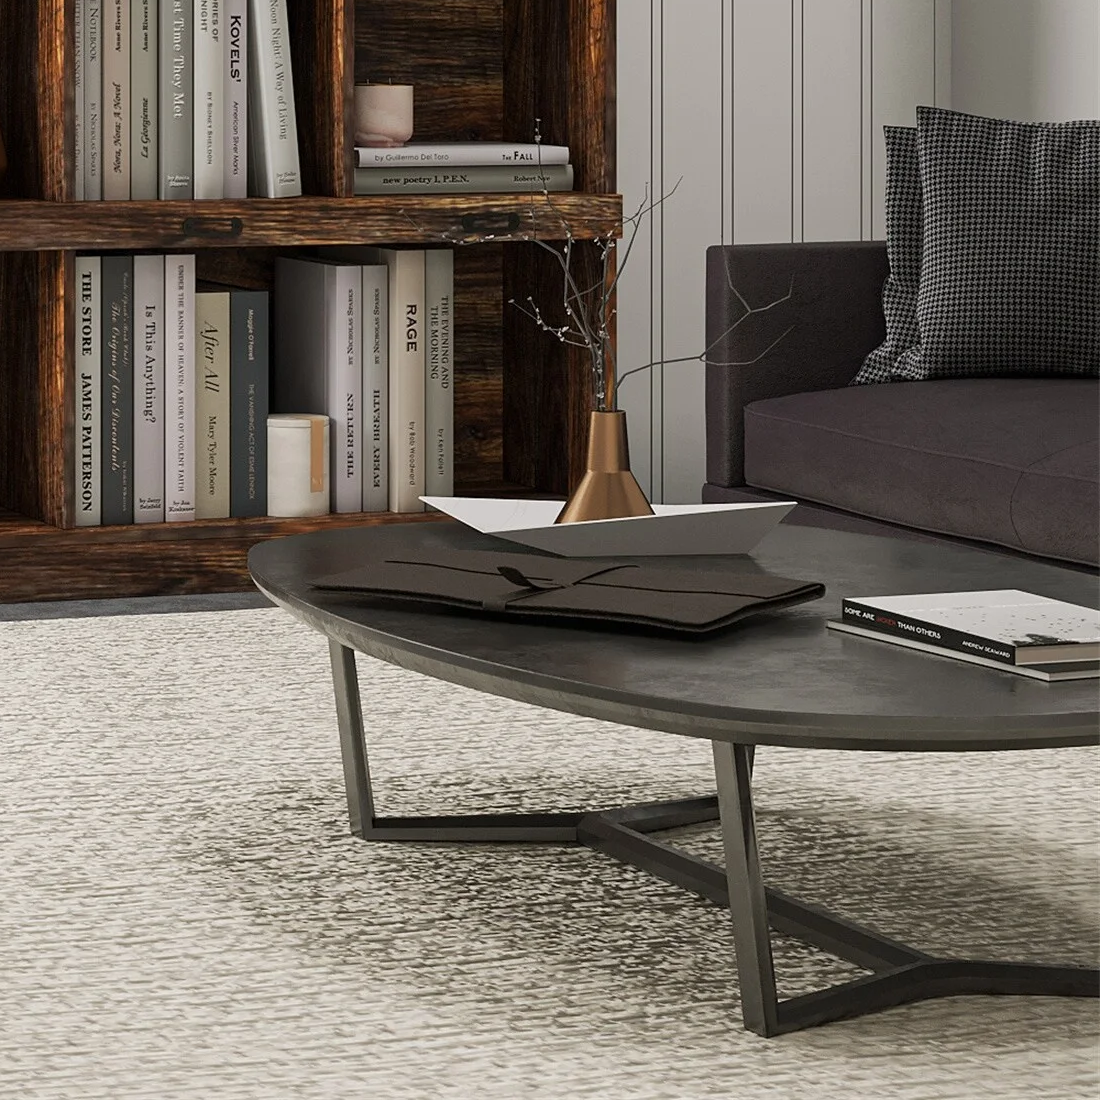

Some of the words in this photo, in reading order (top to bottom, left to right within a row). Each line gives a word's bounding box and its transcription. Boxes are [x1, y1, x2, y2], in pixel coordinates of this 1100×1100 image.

[173, 18, 184, 51] Time
[170, 56, 184, 88] They
[173, 93, 184, 118] Met
[375, 154, 383, 162] by
[383, 176, 400, 184] new
[404, 175, 432, 185] poetry
[443, 174, 469, 183] P.E.N.
[82, 272, 92, 302] THE
[145, 306, 156, 317] Is
[82, 306, 92, 355] STORE
[145, 322, 156, 351] This
[200, 321, 219, 363] After
[407, 305, 417, 352] RAGE
[178, 343, 184, 351] OF
[143, 355, 156, 422] Anything?
[204, 366, 220, 393] All
[82, 373, 92, 421] JAMES
[178, 423, 184, 432] OF
[208, 416, 217, 440] Mary
[82, 426, 92, 511] PATTERSON
[208, 443, 217, 465] Tyler
[209, 468, 217, 495] Moore
[844, 607, 861, 617] SOME
[862, 612, 875, 621] ARE
[898, 621, 915, 632] THAN
[916, 627, 941, 639] OTHERS
